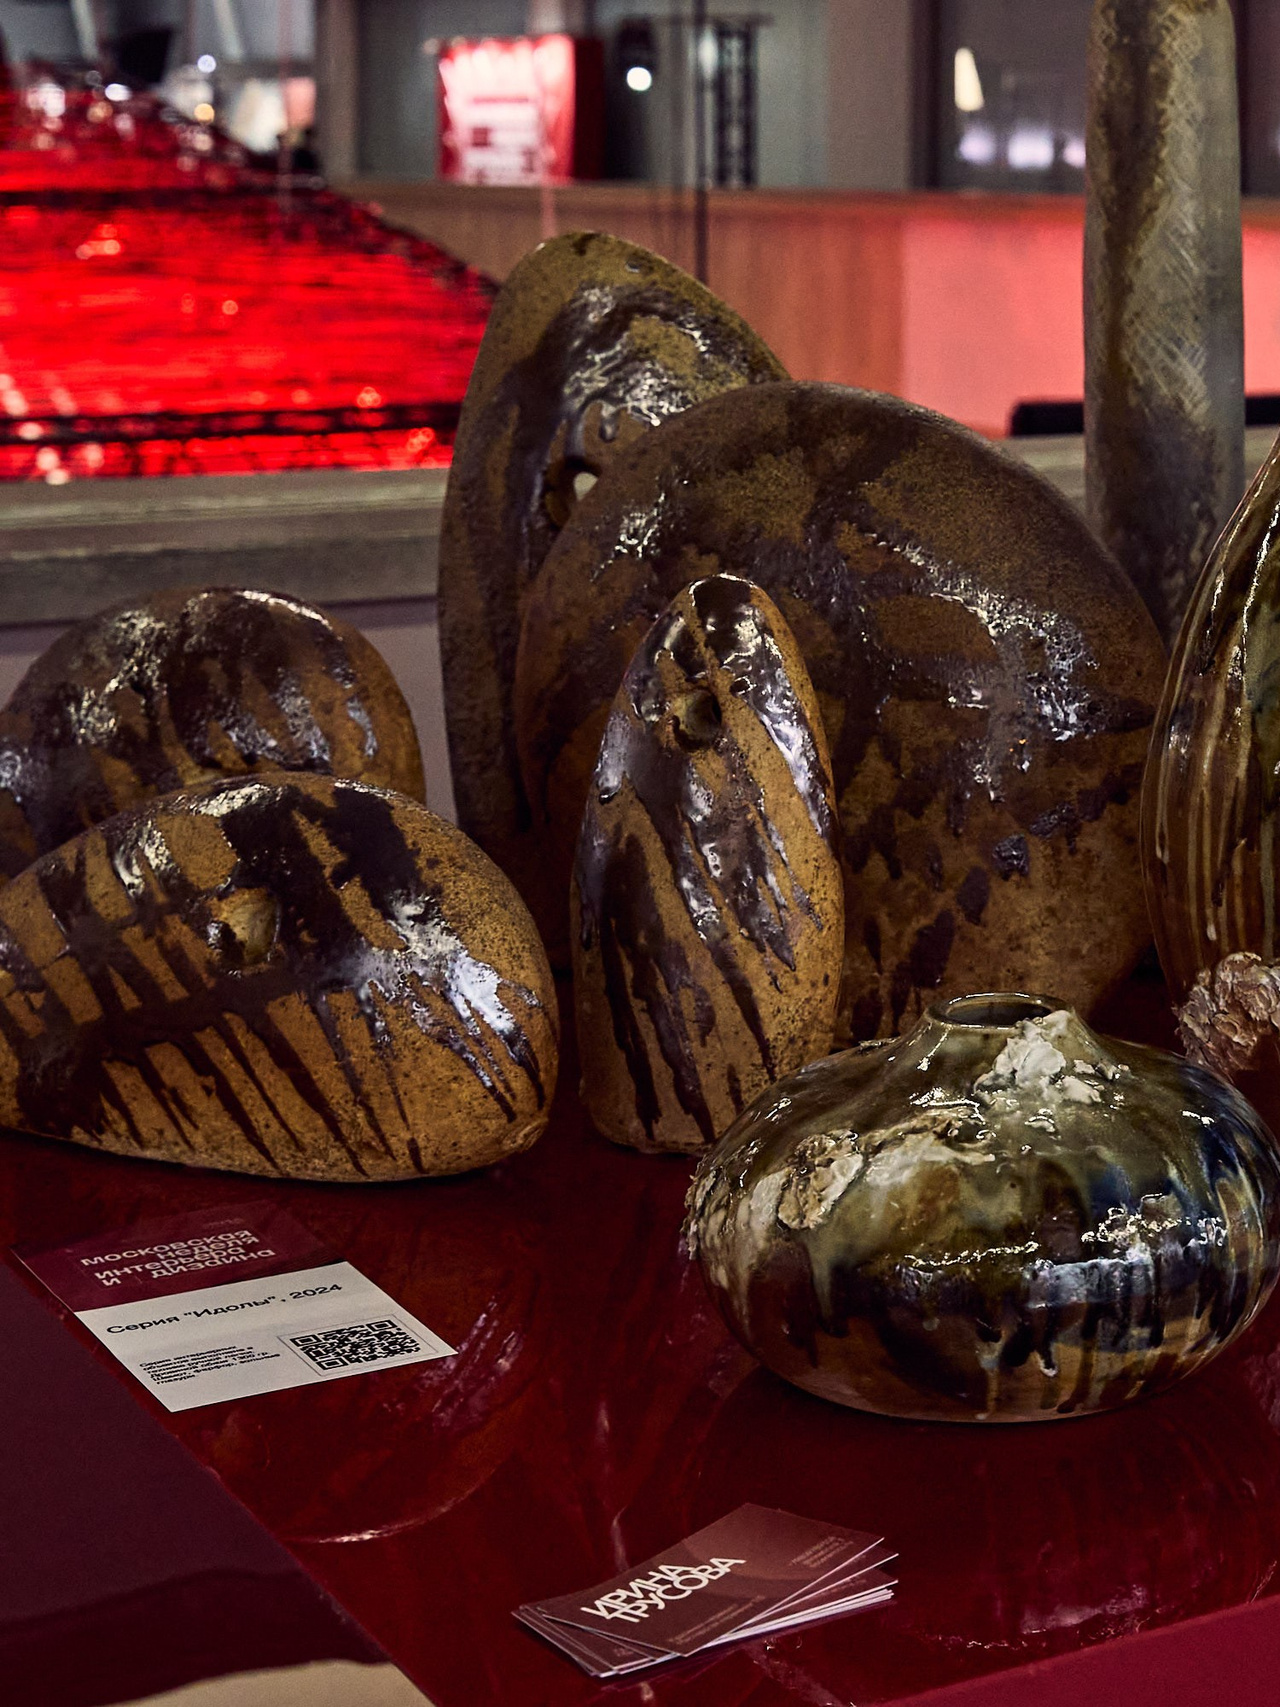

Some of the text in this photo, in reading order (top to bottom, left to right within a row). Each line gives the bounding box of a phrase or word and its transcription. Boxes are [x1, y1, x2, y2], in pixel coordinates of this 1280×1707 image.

[80, 1230, 252, 1266] московская
[94, 1247, 245, 1280] интерьера
[156, 1237, 260, 1259] неделя
[102, 1277, 122, 1287] и
[106, 1315, 180, 1334] Серия
[289, 1284, 342, 1299] 2024
[580, 1565, 696, 1619] ИРИНА
[608, 1557, 747, 1623] ТРУСОВА
